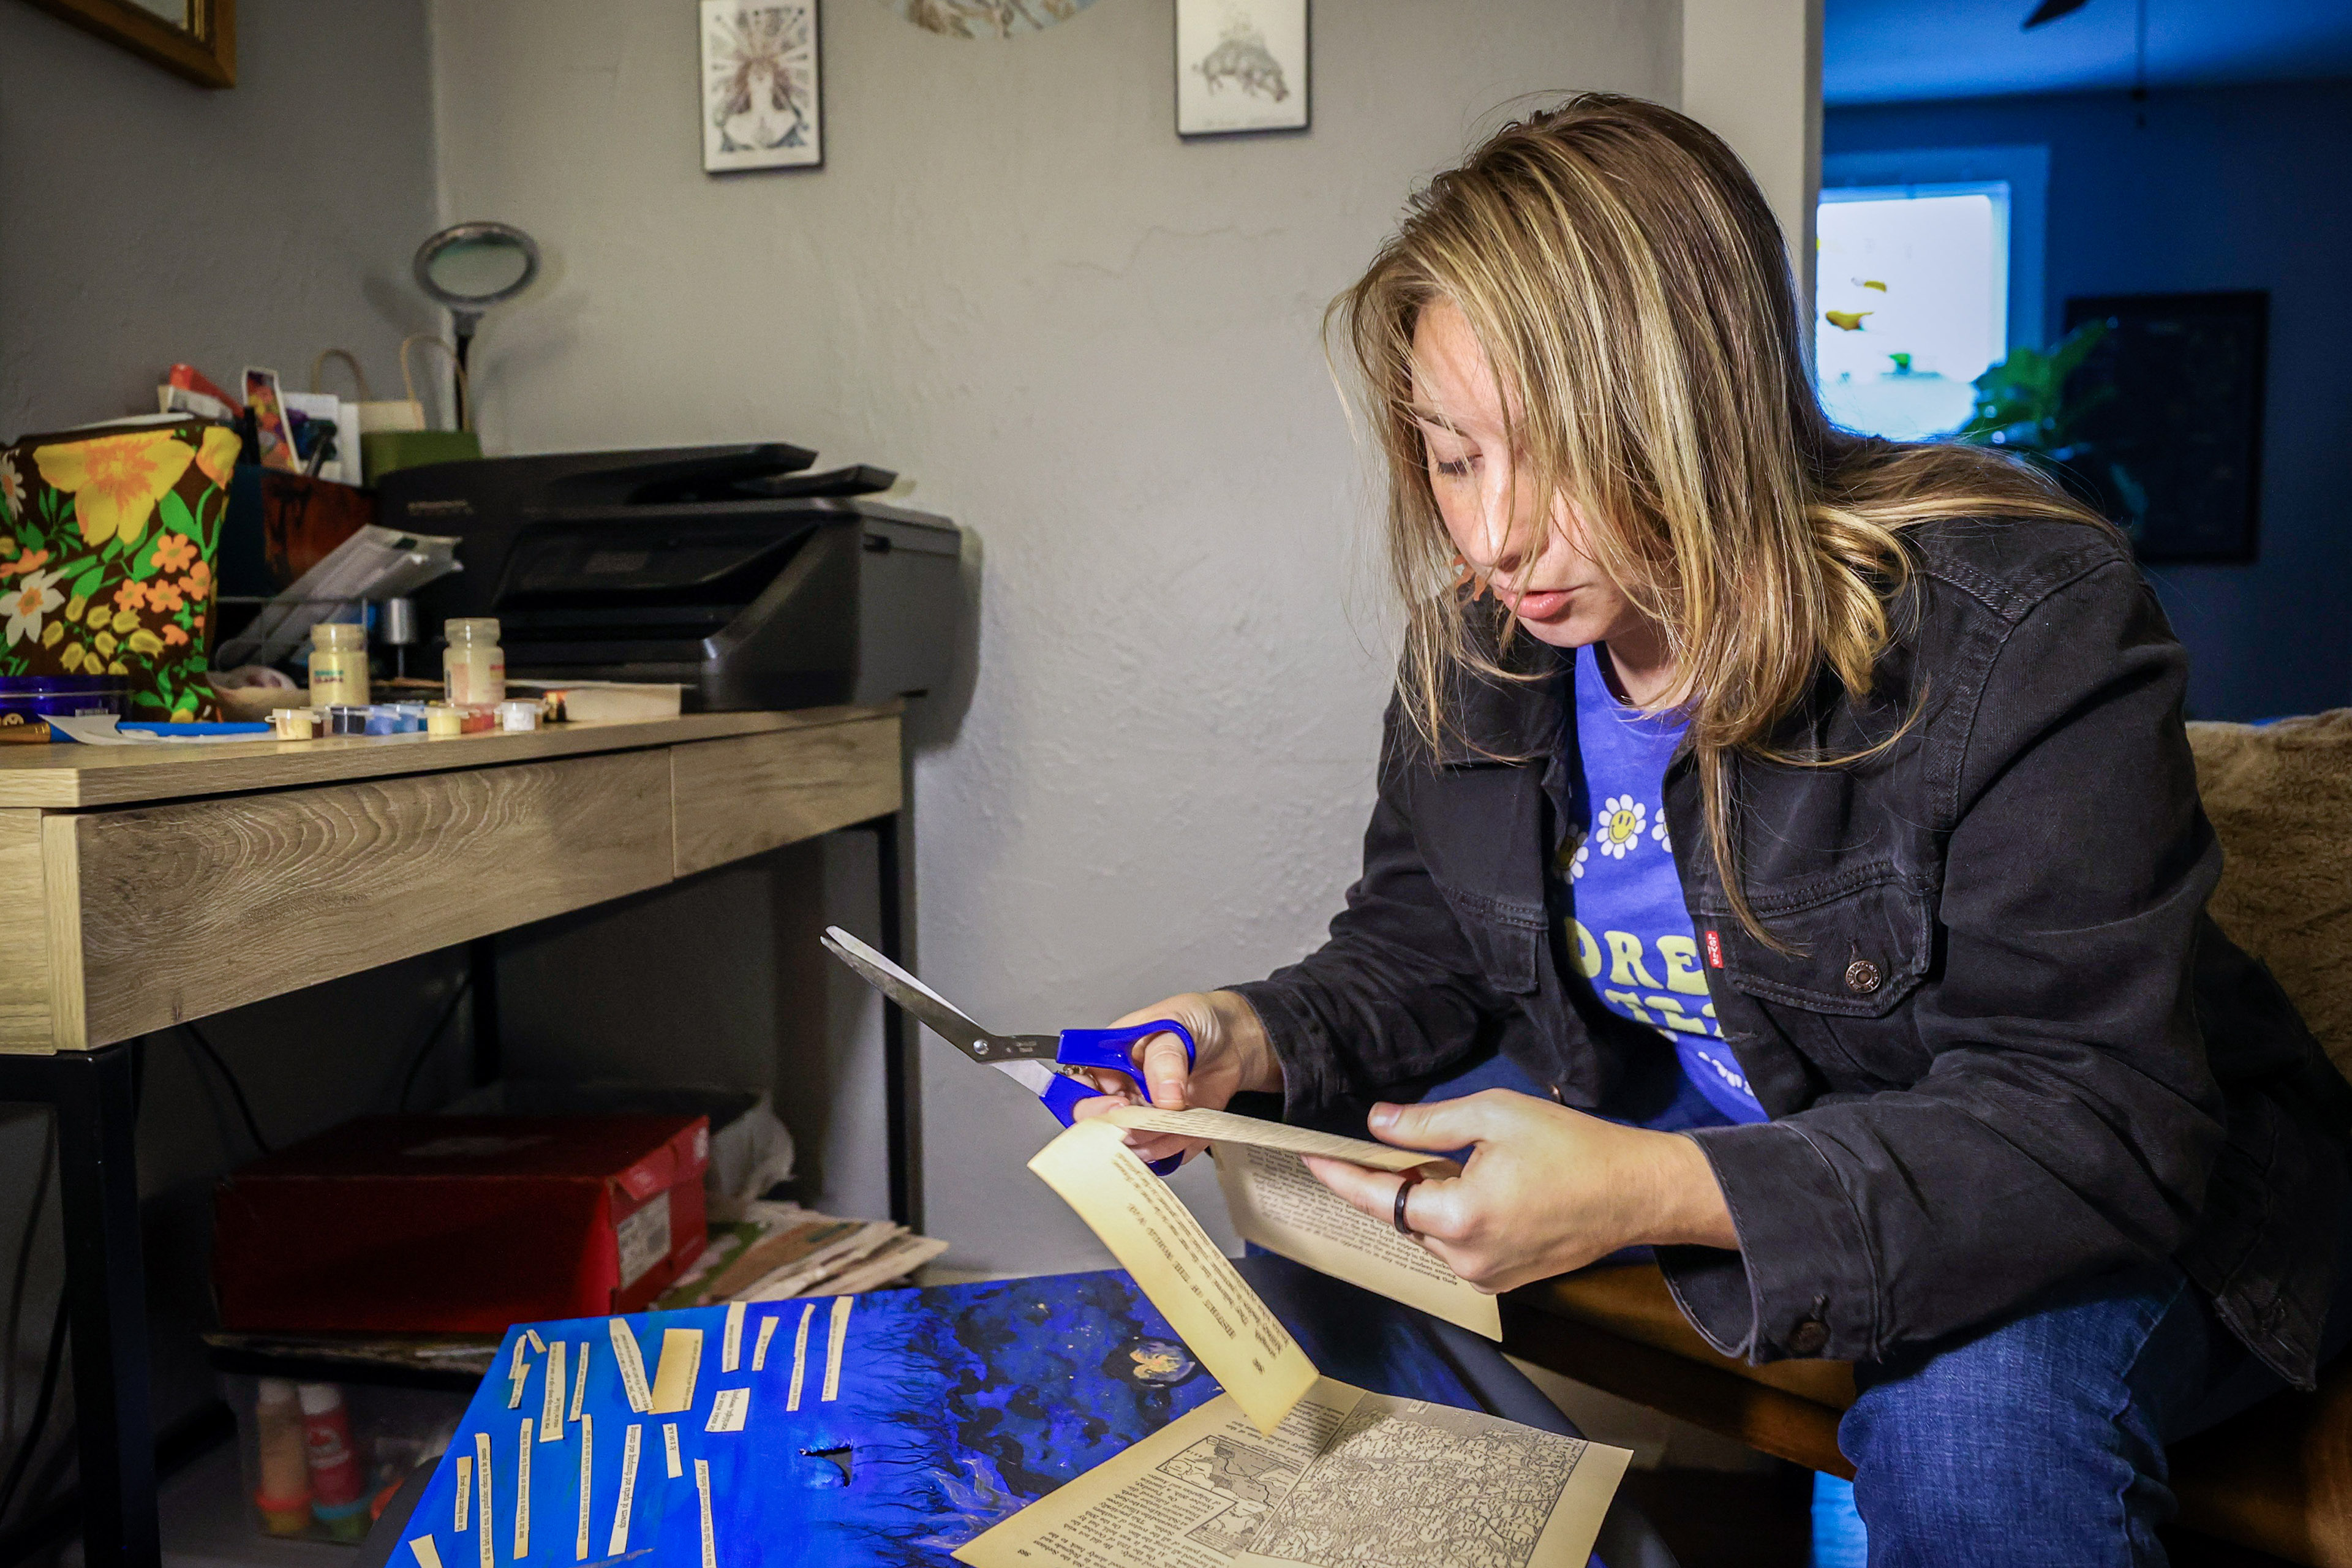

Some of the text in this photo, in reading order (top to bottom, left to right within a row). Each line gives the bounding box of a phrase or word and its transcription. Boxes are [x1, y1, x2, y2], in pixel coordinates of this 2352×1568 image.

[1147, 1226, 1172, 1261] WORLD
[1173, 1261, 1191, 1283] THE
[1189, 1283, 1204, 1298] OF
[1203, 1298, 1235, 1340] HISTORY
[1140, 1477, 1166, 1488] junction
[1139, 1491, 1169, 1504] followed
[1183, 1488, 1212, 1502] Bulgarian
[1099, 1502, 1131, 1517] practically
[1122, 1505, 1139, 1513] Allied
[1140, 1498, 1161, 1508] further
[1140, 1504, 1155, 1512] from
[1189, 1498, 1213, 1509] October
[1092, 1506, 1118, 1519] southern
[1155, 1510, 1180, 1523] Saloniki
[1163, 1507, 1183, 1517] armies
[1172, 1504, 1200, 1518] Disaster
[617, 1509, 627, 1528] showers
[1150, 1516, 1181, 1530] separated
[1082, 1525, 1106, 1537] October
[1128, 1523, 1148, 1532] routes
[1154, 1525, 1174, 1536] Serbia.
[1033, 1540, 1058, 1554] Serbians
[1055, 1543, 1080, 1558] Belgrade
[1070, 1542, 1085, 1552] back
[1153, 1540, 1171, 1550] along
[1182, 1545, 1200, 1554] point
[1088, 1551, 1107, 1561] slowly
[1181, 1553, 1207, 1566] forward
